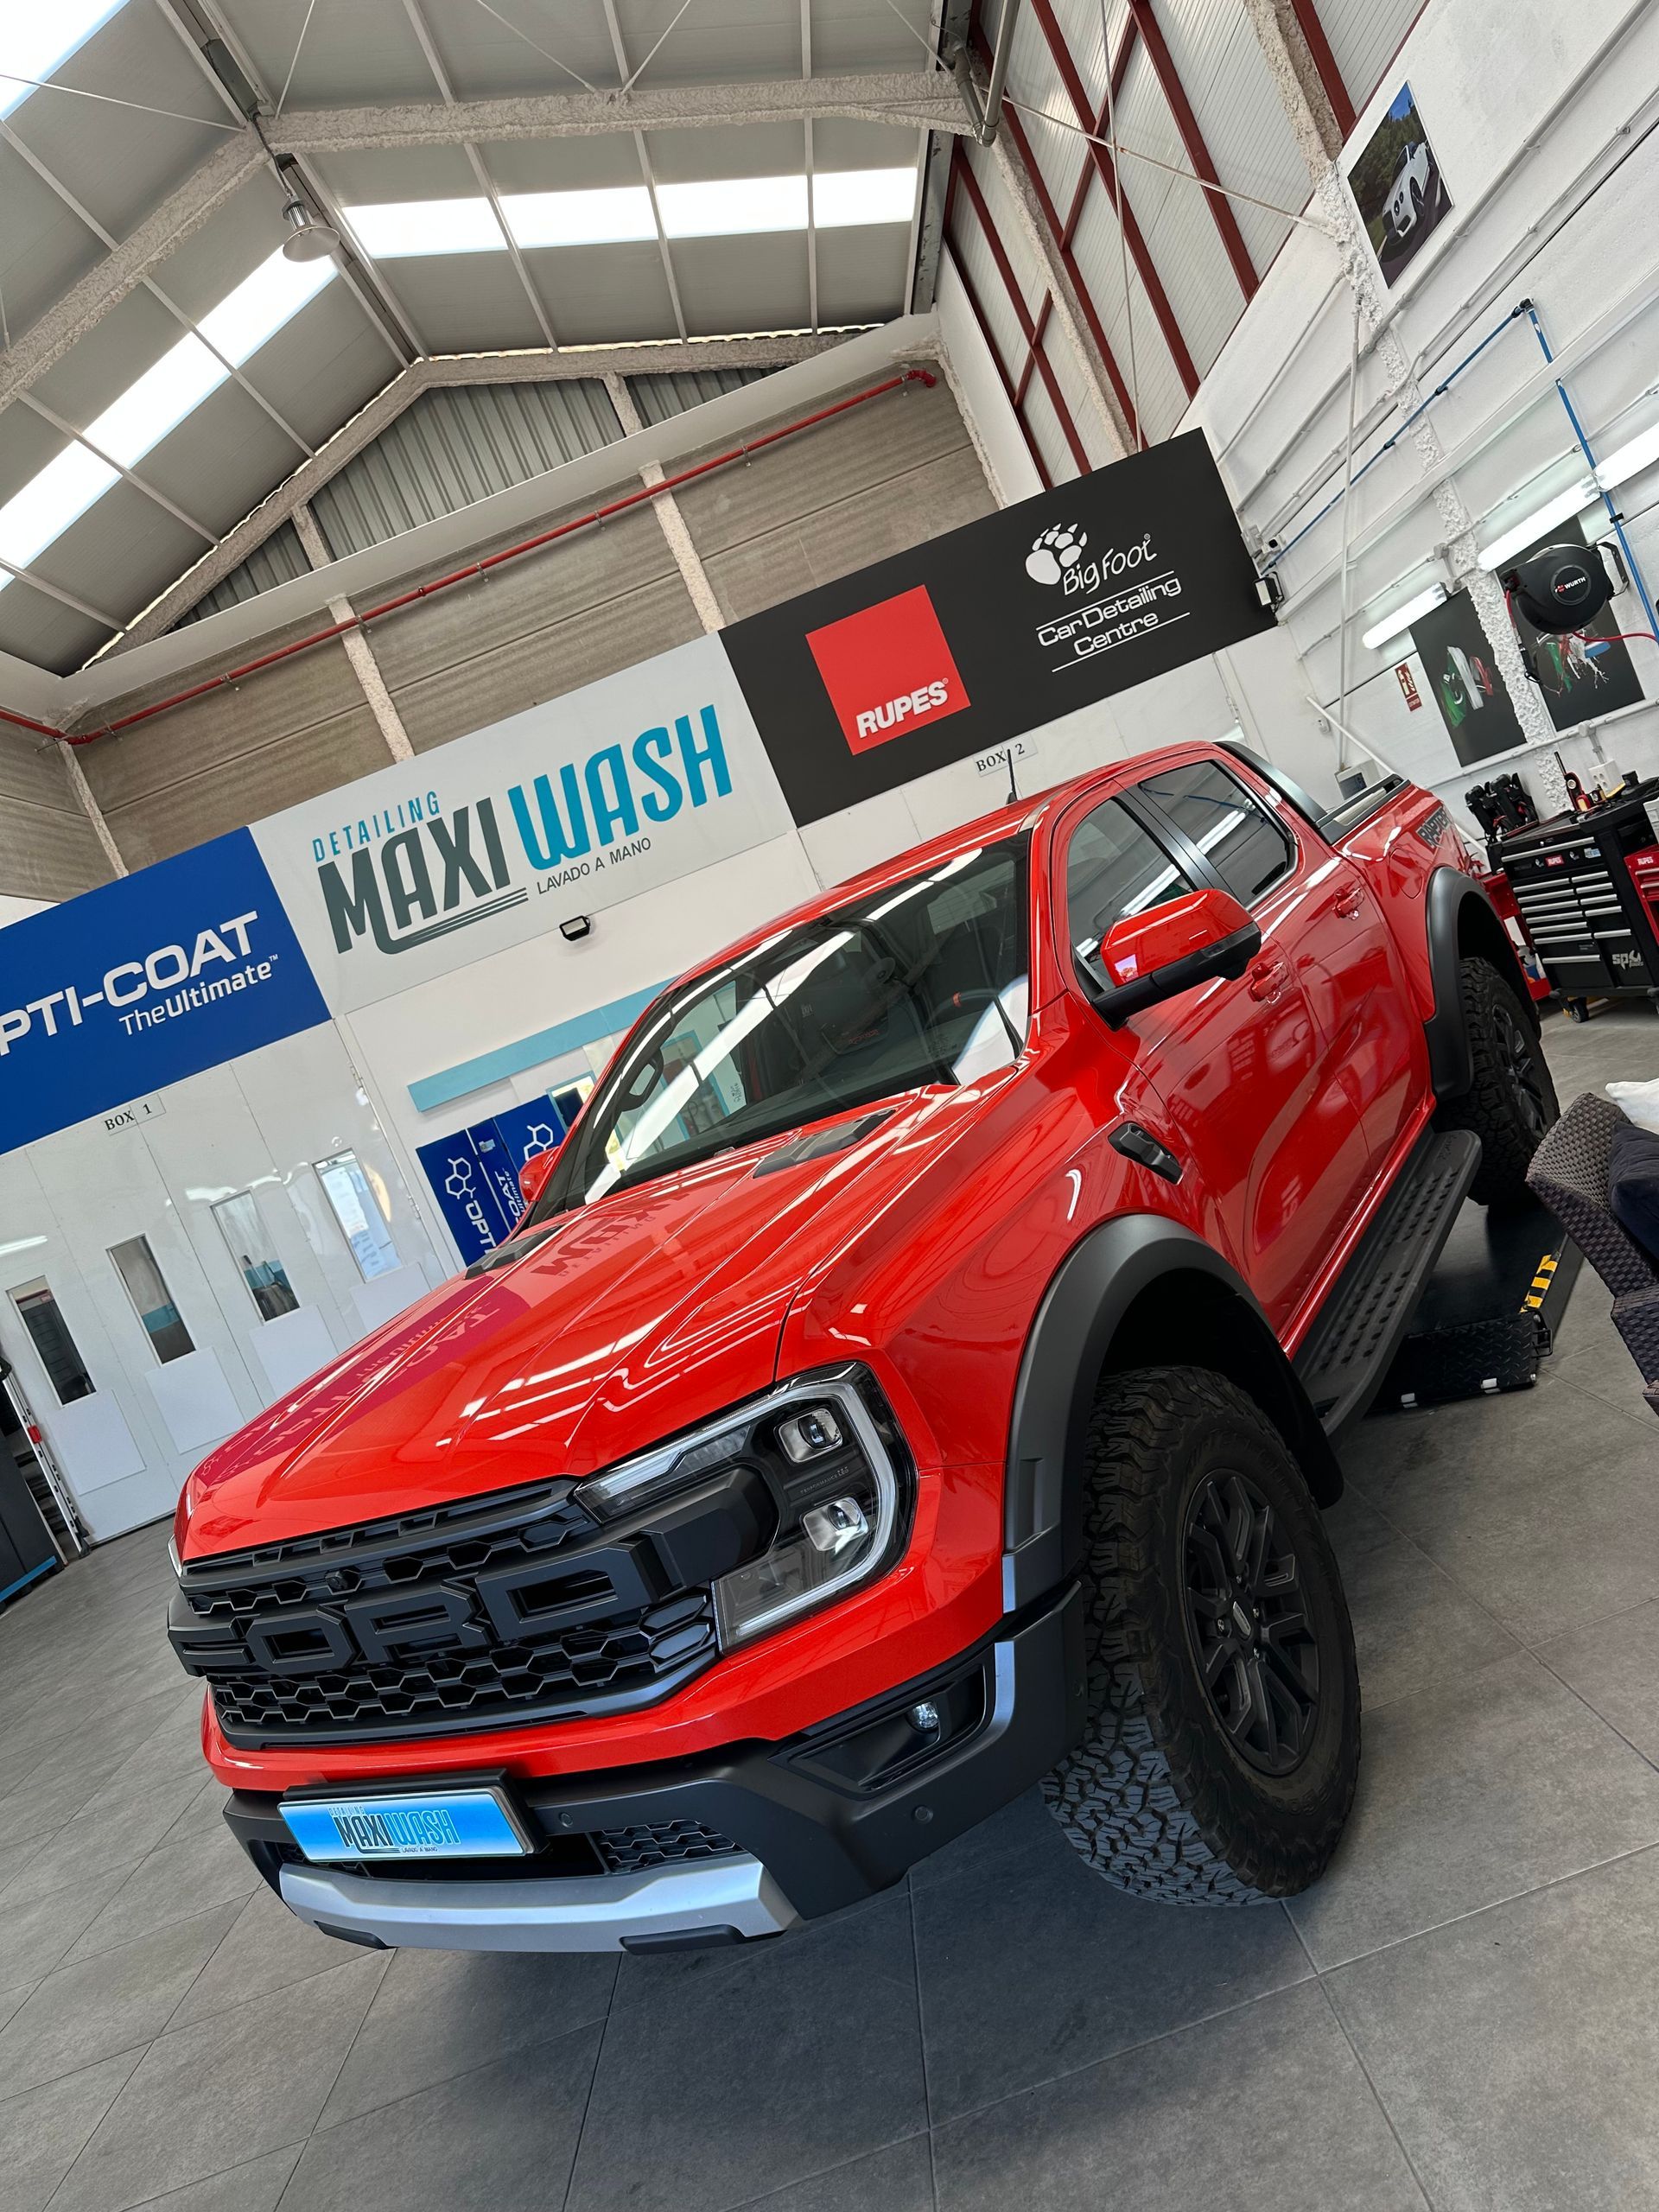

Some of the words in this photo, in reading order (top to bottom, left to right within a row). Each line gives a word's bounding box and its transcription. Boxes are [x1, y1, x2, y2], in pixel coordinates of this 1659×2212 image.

[1073, 613, 1159, 656] Centre
[976, 751, 1007, 772] BOX
[1014, 743, 1026, 755] 2
[312, 791, 440, 862] DETAILING
[317, 797, 512, 955] MAXI
[507, 704, 733, 870] WASH
[537, 862, 590, 895] LAVADO
[594, 856, 606, 872] A
[609, 837, 652, 865] MANO
[104, 1110, 135, 1130] BOX
[143, 1103, 152, 1115] 1
[494, 1171, 520, 1224] OAT
[167, 1534, 658, 1677] FORD
[333, 1814, 394, 1853] MAXI
[385, 1810, 461, 1846] WASH
